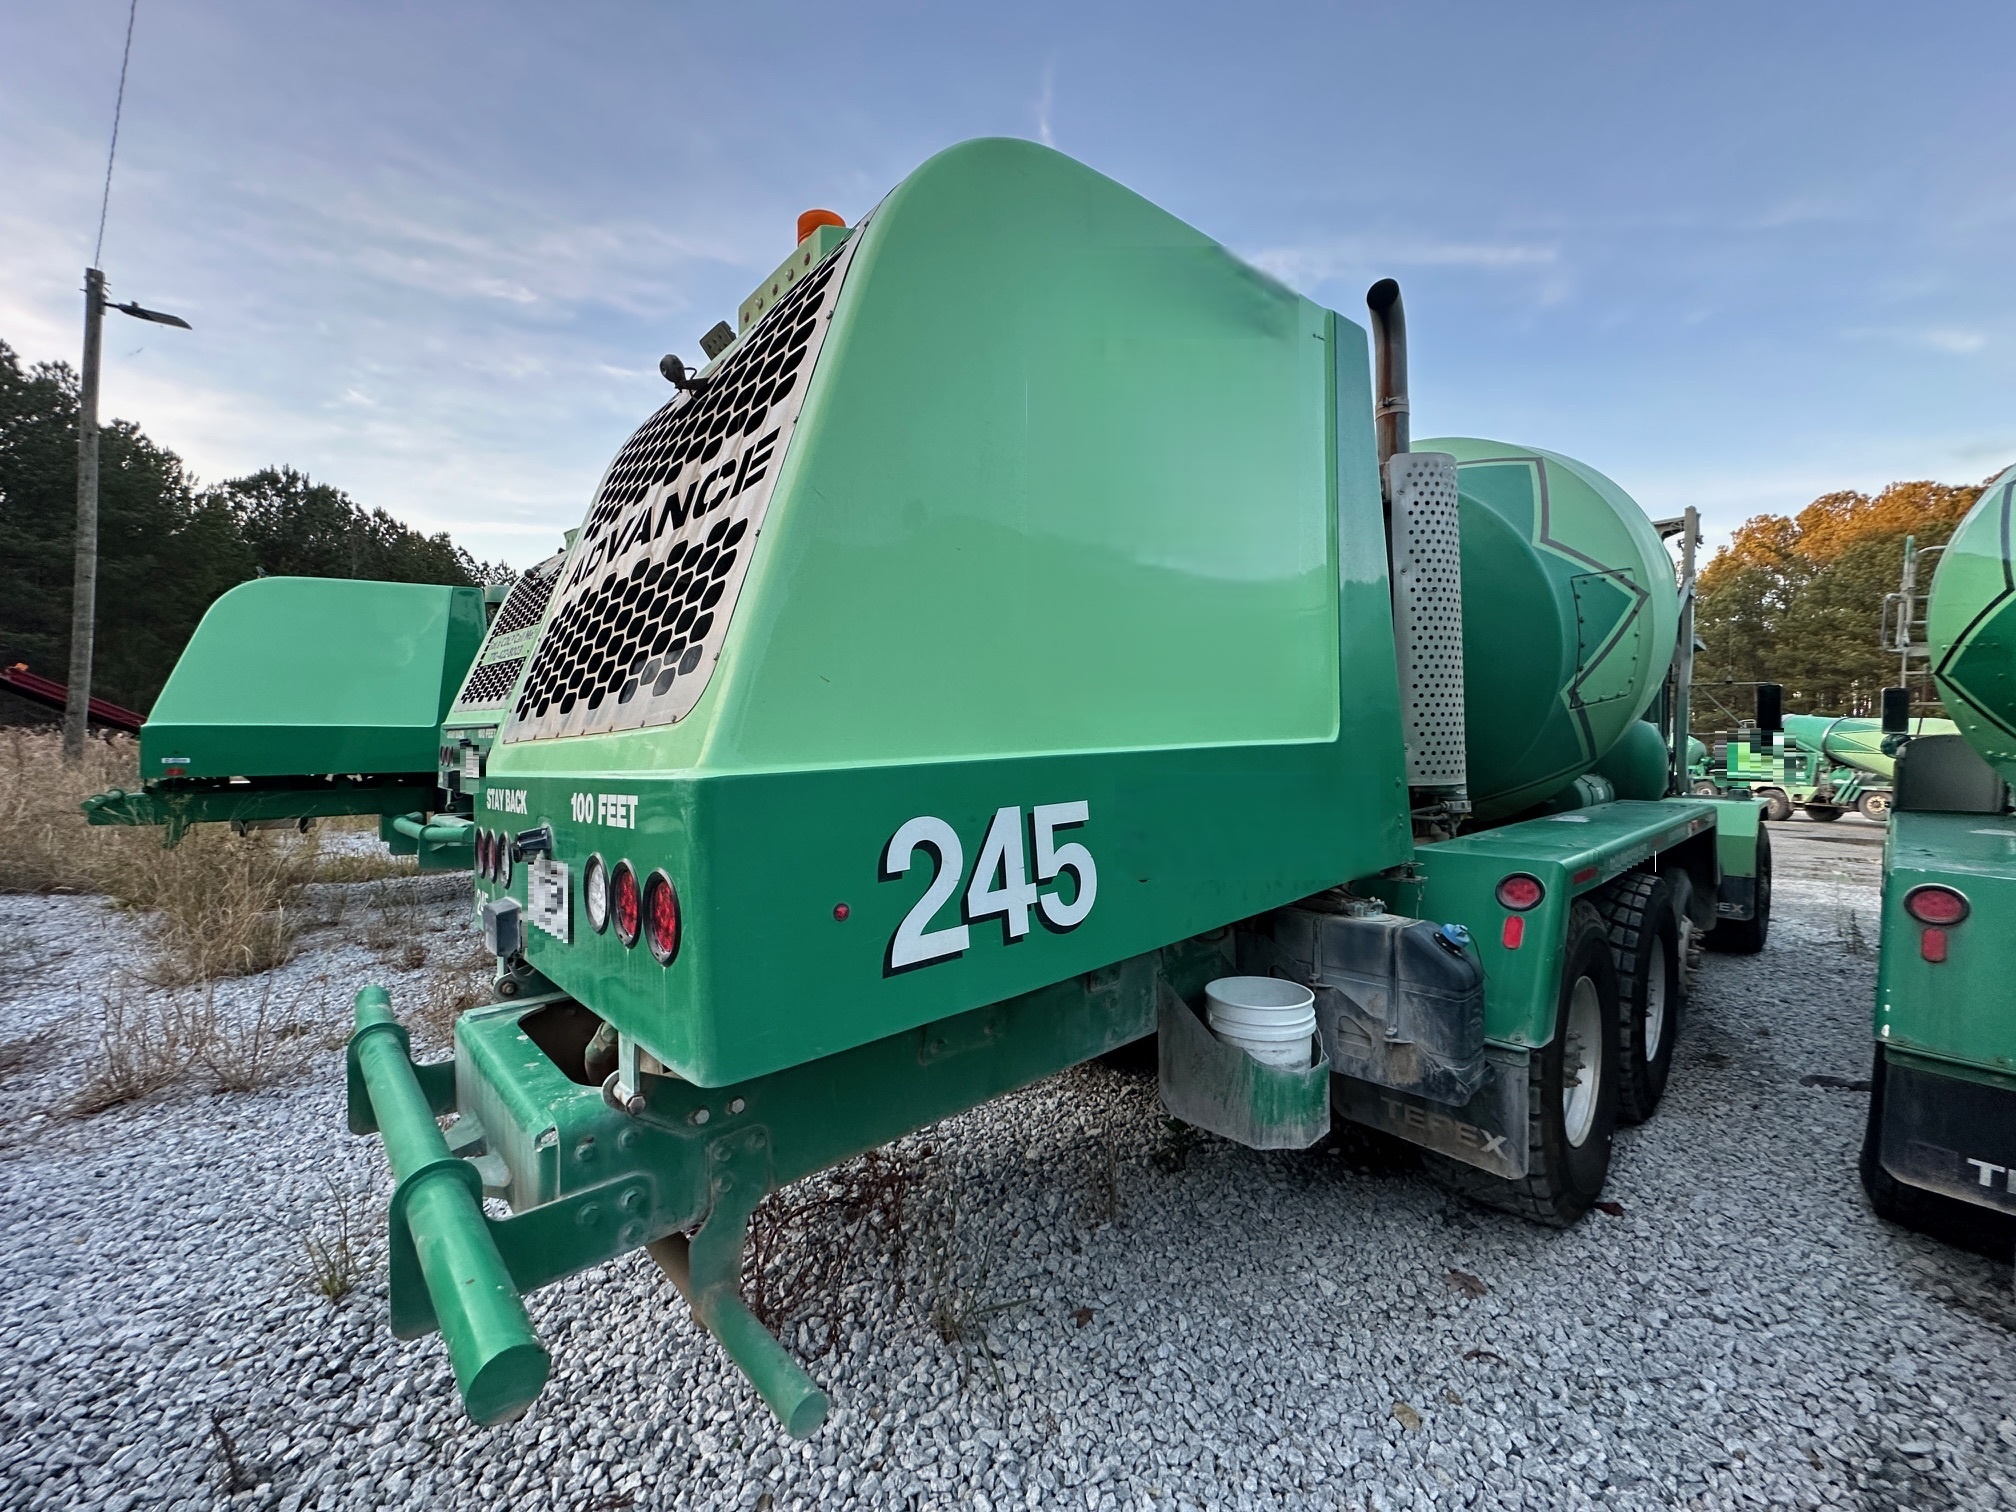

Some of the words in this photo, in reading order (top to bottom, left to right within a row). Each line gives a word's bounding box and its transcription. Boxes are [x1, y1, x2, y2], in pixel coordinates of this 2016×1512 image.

[562, 426, 781, 596] ADVANCE
[486, 788, 505, 812] STAY
[505, 789, 528, 815] BACK
[571, 792, 594, 824] 100
[597, 793, 639, 829] FEET
[879, 800, 1097, 978] 245
